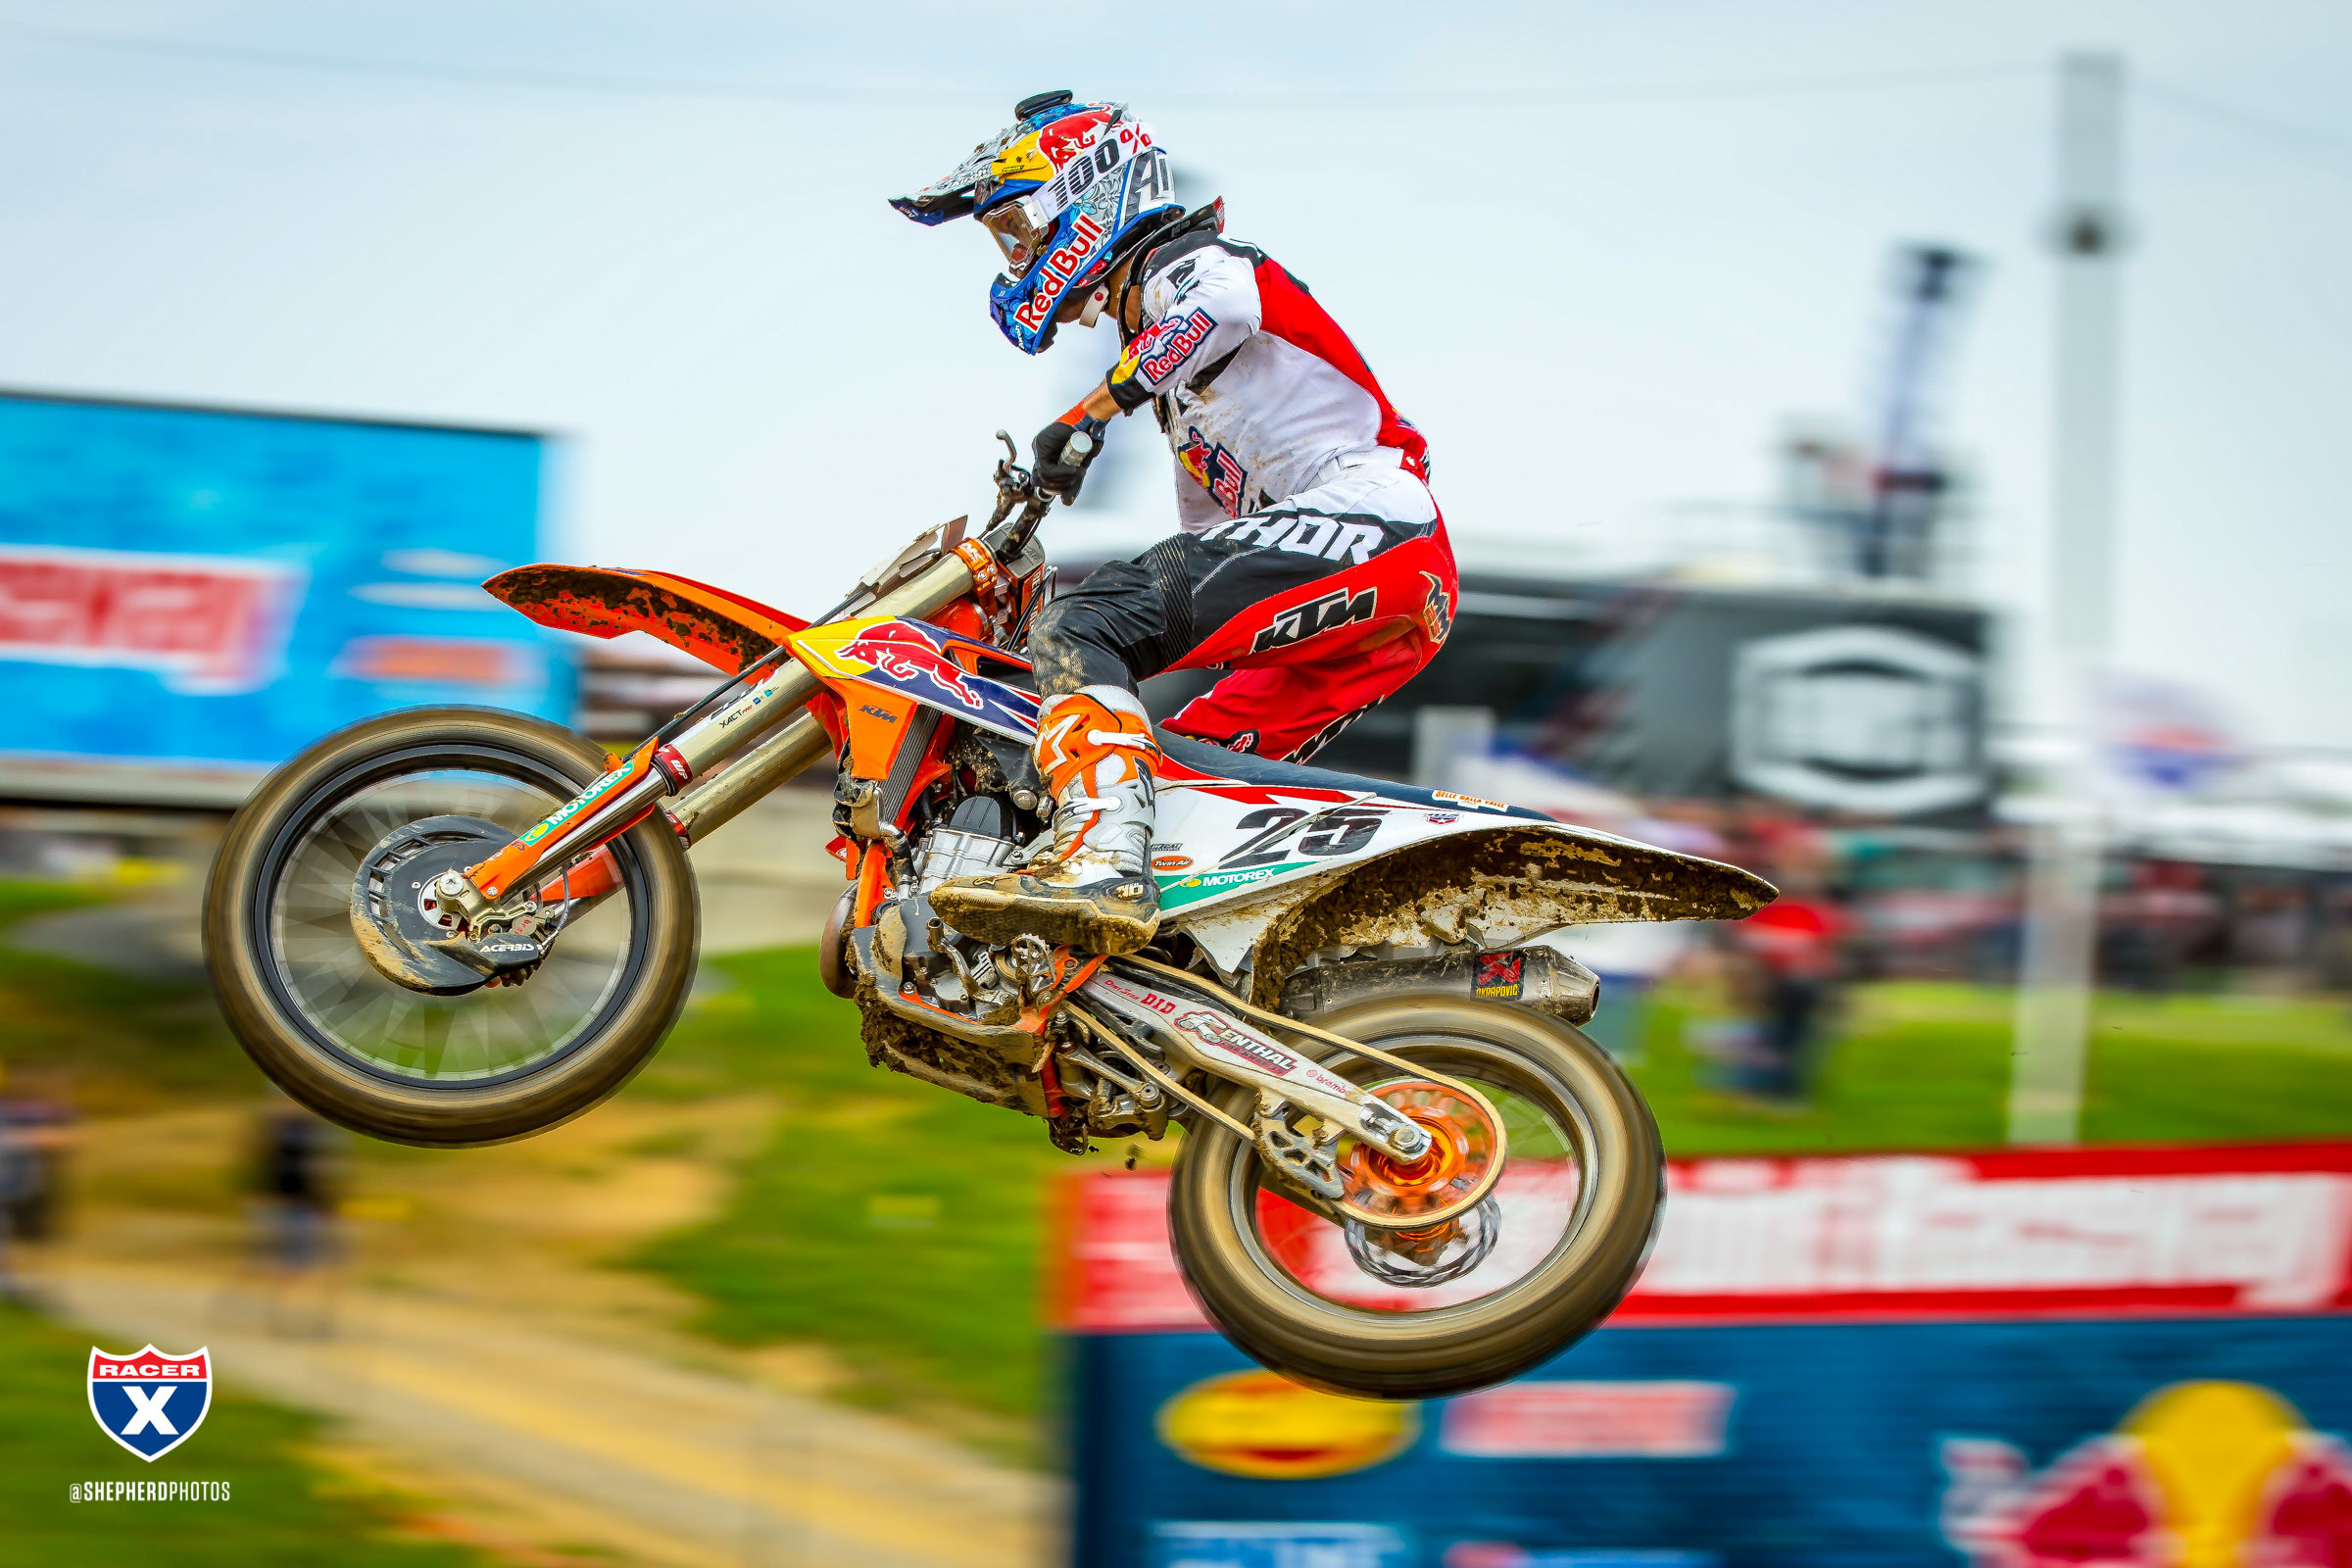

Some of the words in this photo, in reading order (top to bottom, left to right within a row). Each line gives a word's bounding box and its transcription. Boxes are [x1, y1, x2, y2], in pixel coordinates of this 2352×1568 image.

[1013, 266, 1064, 332] Red
[1058, 213, 1107, 278] Bull
[1143, 347, 1185, 381] Red
[1171, 311, 1212, 356] Bull
[1200, 515, 1385, 565] THOR
[1250, 587, 1377, 655] KTM
[719, 709, 743, 729] XACT
[859, 704, 898, 723] KTM
[550, 764, 632, 825] MOTOREX
[1218, 808, 1392, 870] 25
[1202, 867, 1275, 887] MOTOREX
[478, 943, 535, 953] ACERBIS
